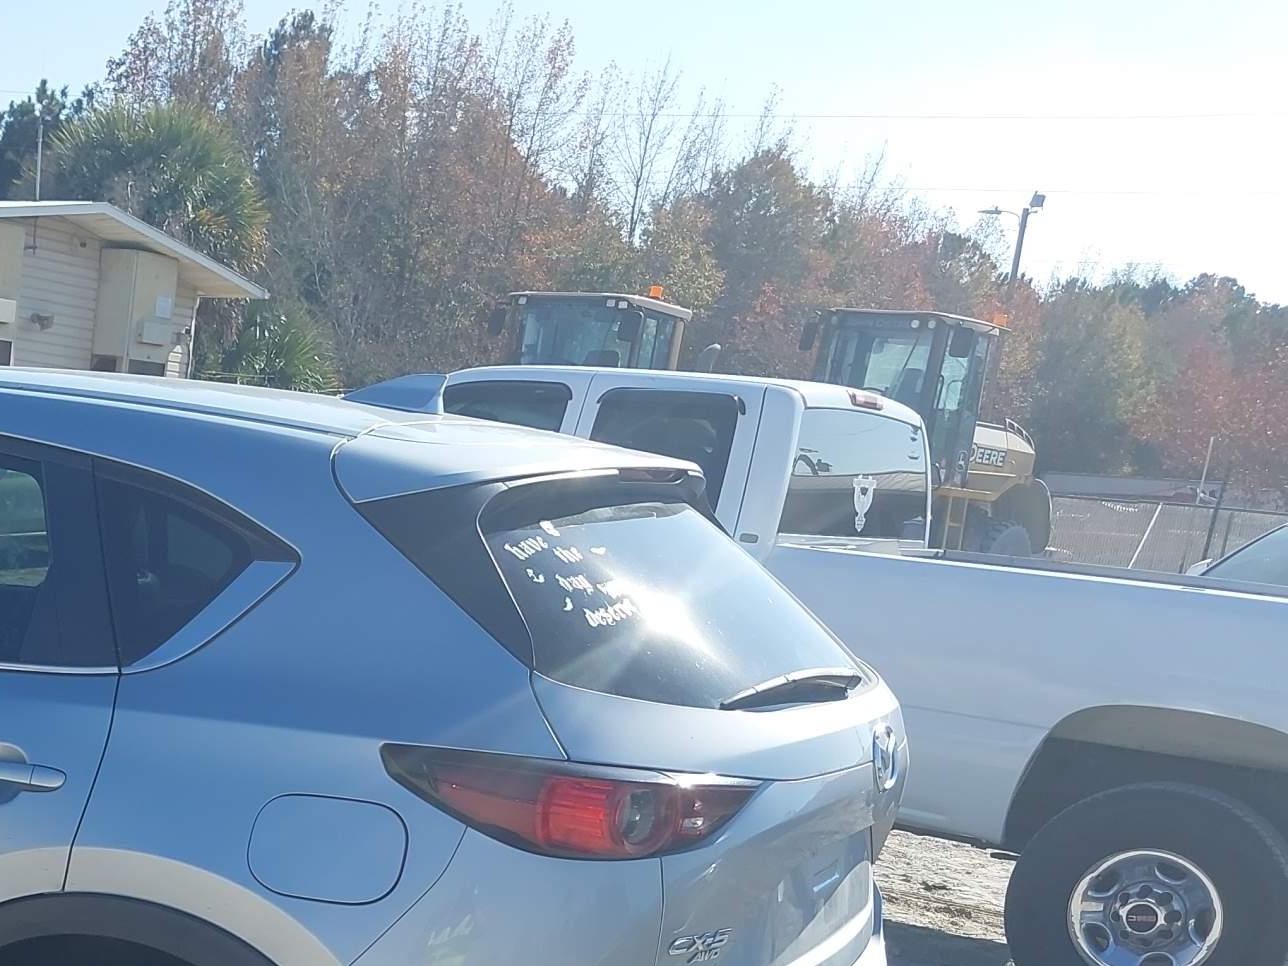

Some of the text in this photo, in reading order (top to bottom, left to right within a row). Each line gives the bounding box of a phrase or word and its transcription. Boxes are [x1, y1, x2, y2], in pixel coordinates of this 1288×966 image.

[969, 444, 1006, 466] DEERE
[503, 535, 549, 561] have
[668, 926, 733, 956] CX-5
[687, 948, 721, 965] AWD
